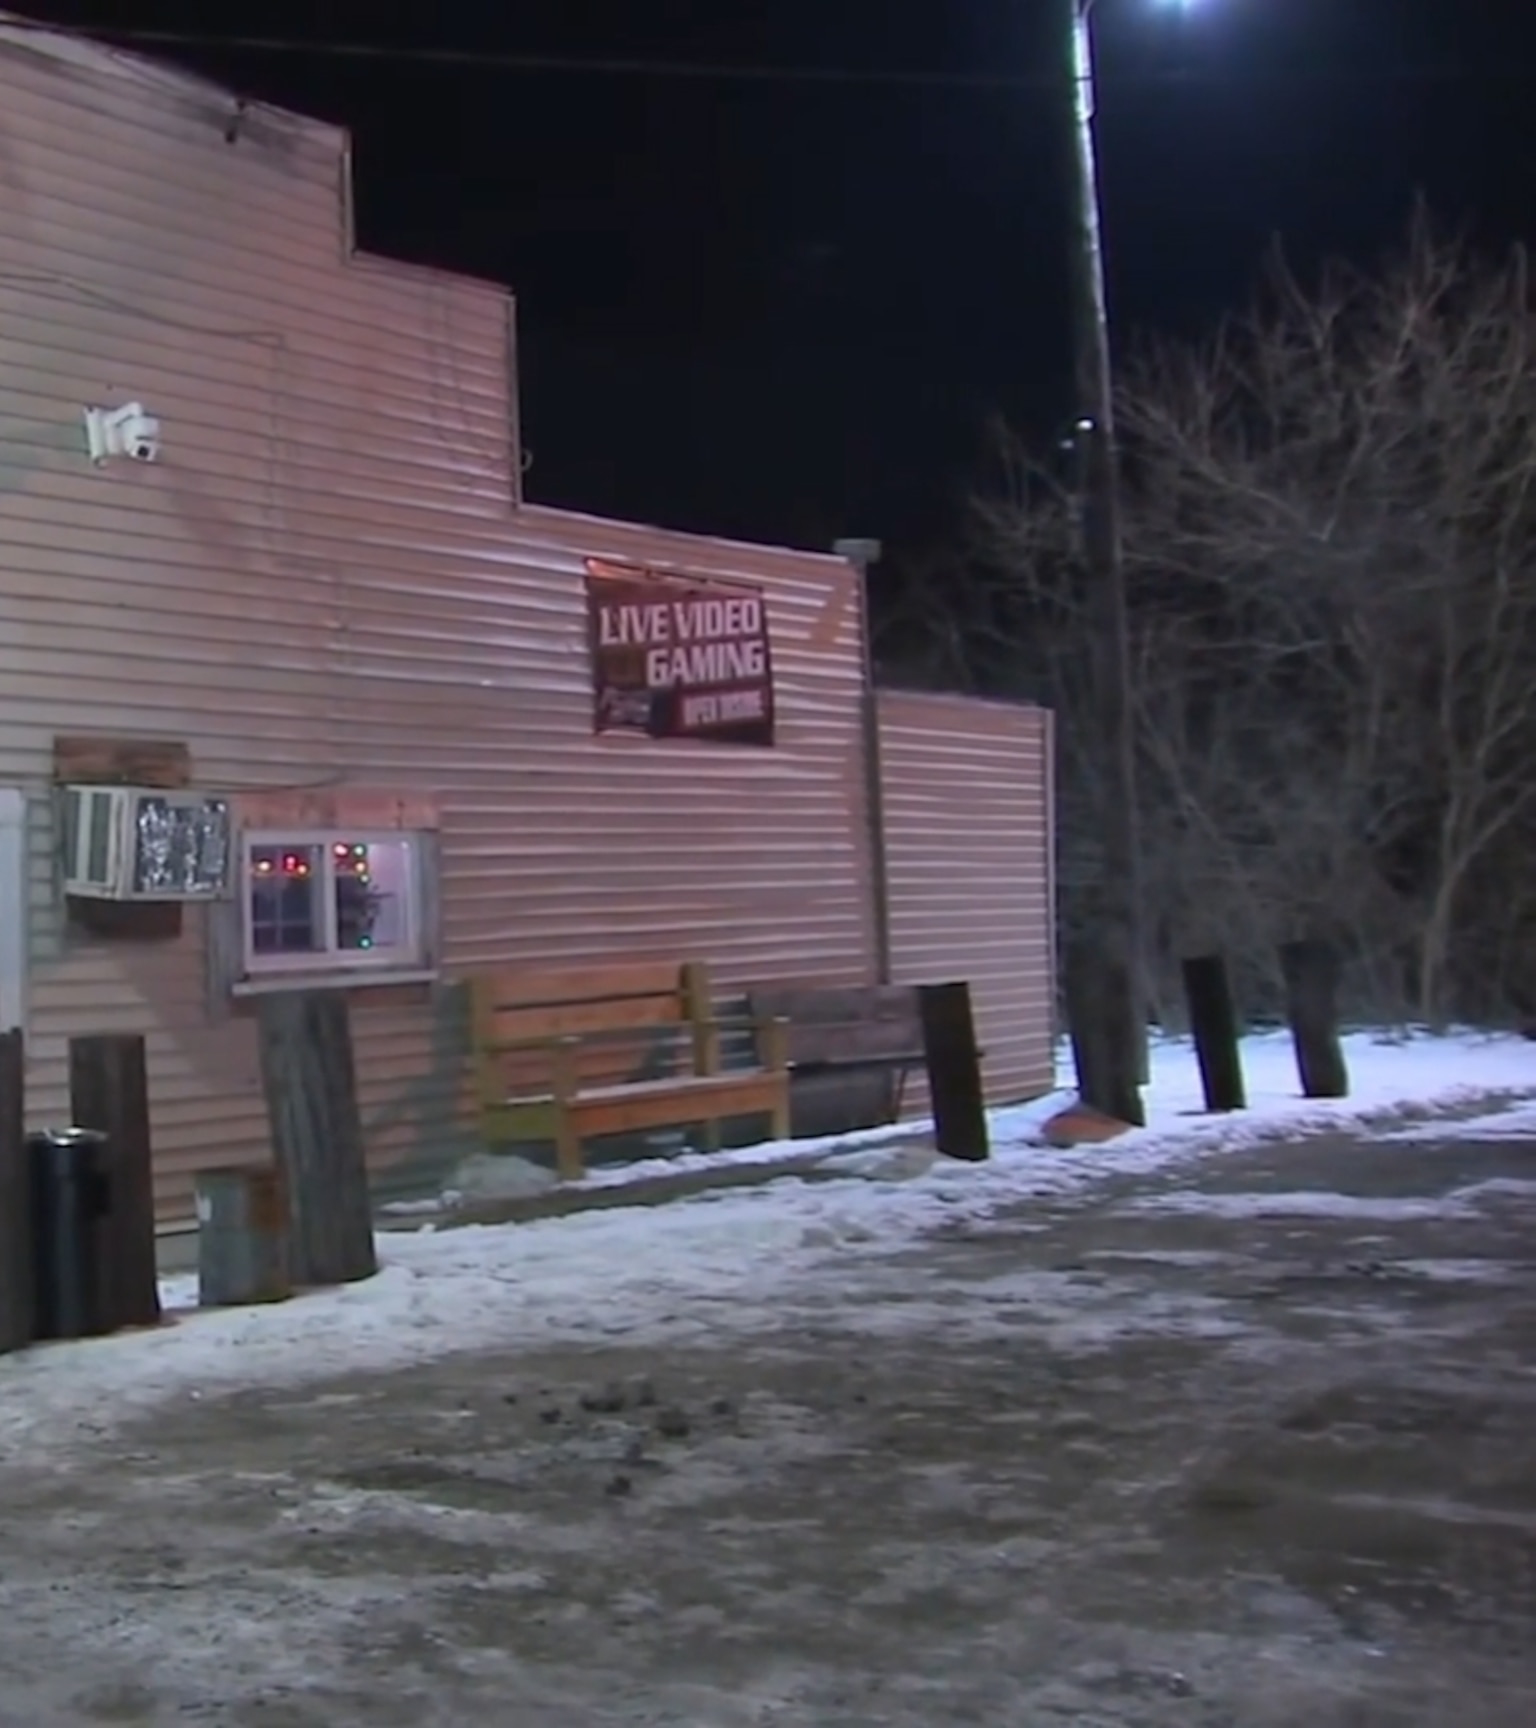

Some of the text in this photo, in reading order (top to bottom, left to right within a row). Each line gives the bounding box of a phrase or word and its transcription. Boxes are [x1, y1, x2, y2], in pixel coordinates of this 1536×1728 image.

[600, 599, 761, 645] LIVE VIDEO
[646, 640, 765, 687] GAMING
